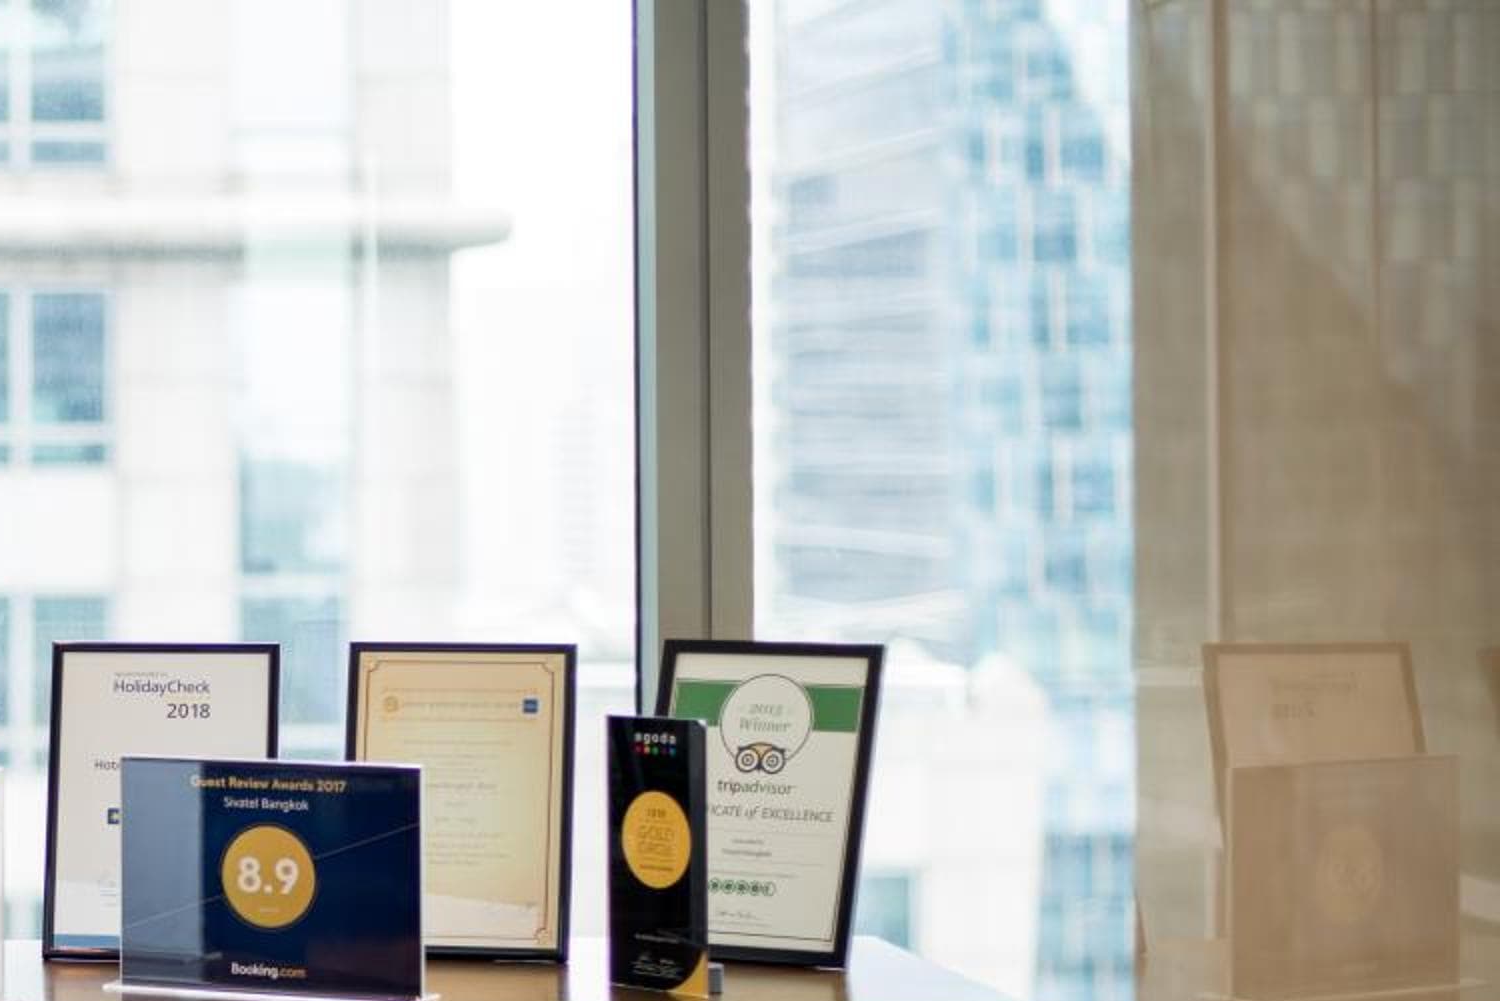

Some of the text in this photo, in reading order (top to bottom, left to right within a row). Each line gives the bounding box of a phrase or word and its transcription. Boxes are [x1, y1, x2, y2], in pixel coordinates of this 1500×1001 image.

[113, 679, 211, 698] HolidayCheck
[166, 703, 211, 719] 2018
[739, 717, 793, 733] Winner
[633, 732, 677, 744] agoda
[190, 775, 348, 793] Guest Review Awards 2017
[717, 780, 794, 796] tripadvisor
[223, 797, 309, 813] Sivatel Bangkok
[708, 803, 741, 818] ICATE
[761, 807, 837, 823] EXCELLENCE
[237, 856, 299, 895] 8.9
[231, 962, 307, 979] Booking.com
